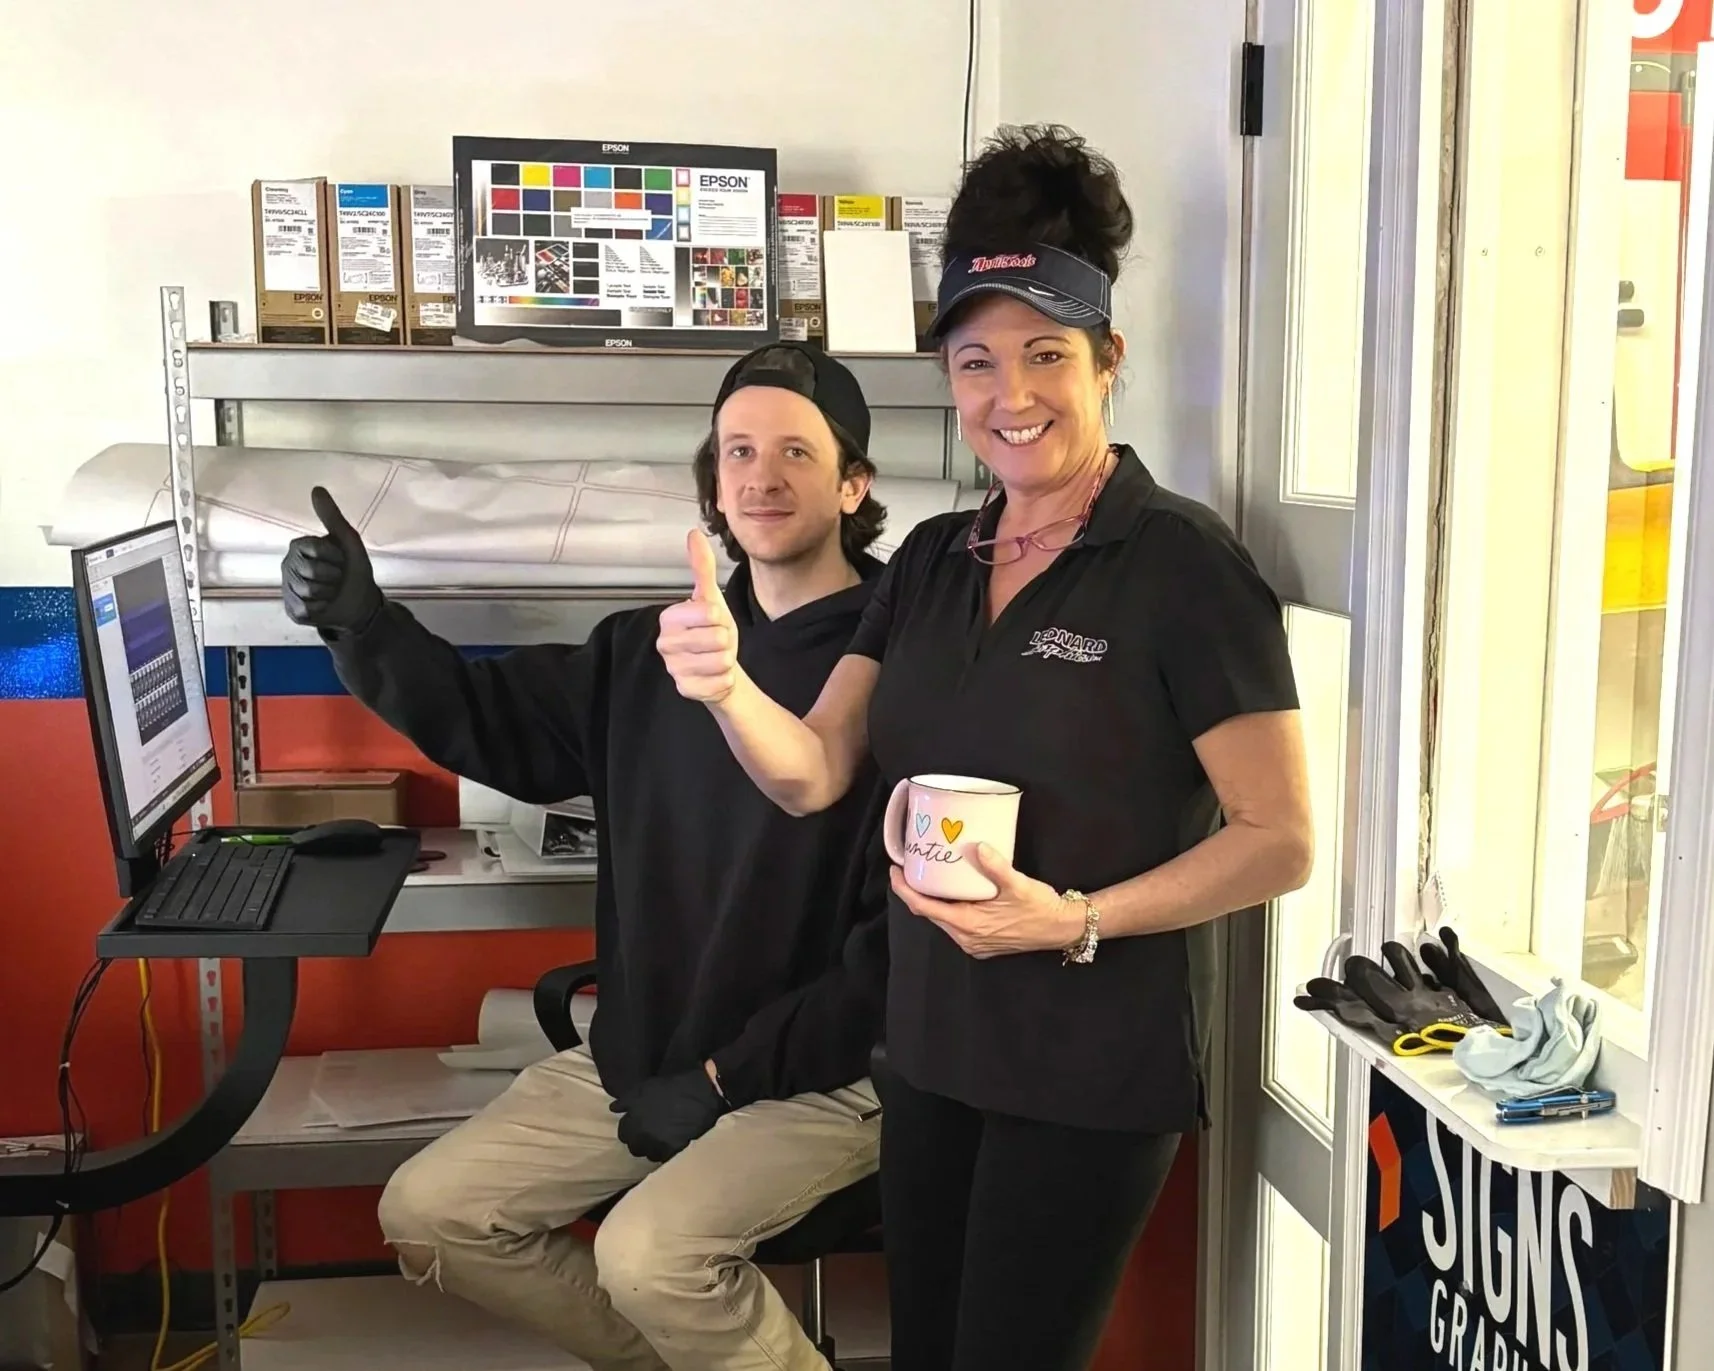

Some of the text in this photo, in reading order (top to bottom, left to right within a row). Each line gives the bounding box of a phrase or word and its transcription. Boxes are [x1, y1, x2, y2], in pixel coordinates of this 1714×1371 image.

[602, 144, 630, 152] EPSON
[700, 174, 748, 188] EPSON
[294, 293, 323, 301] EPSON
[369, 294, 397, 302] EPSON
[795, 303, 821, 311] EPSON
[605, 339, 632, 347] EPSON
[1421, 1108, 1593, 1371] SIGNS
